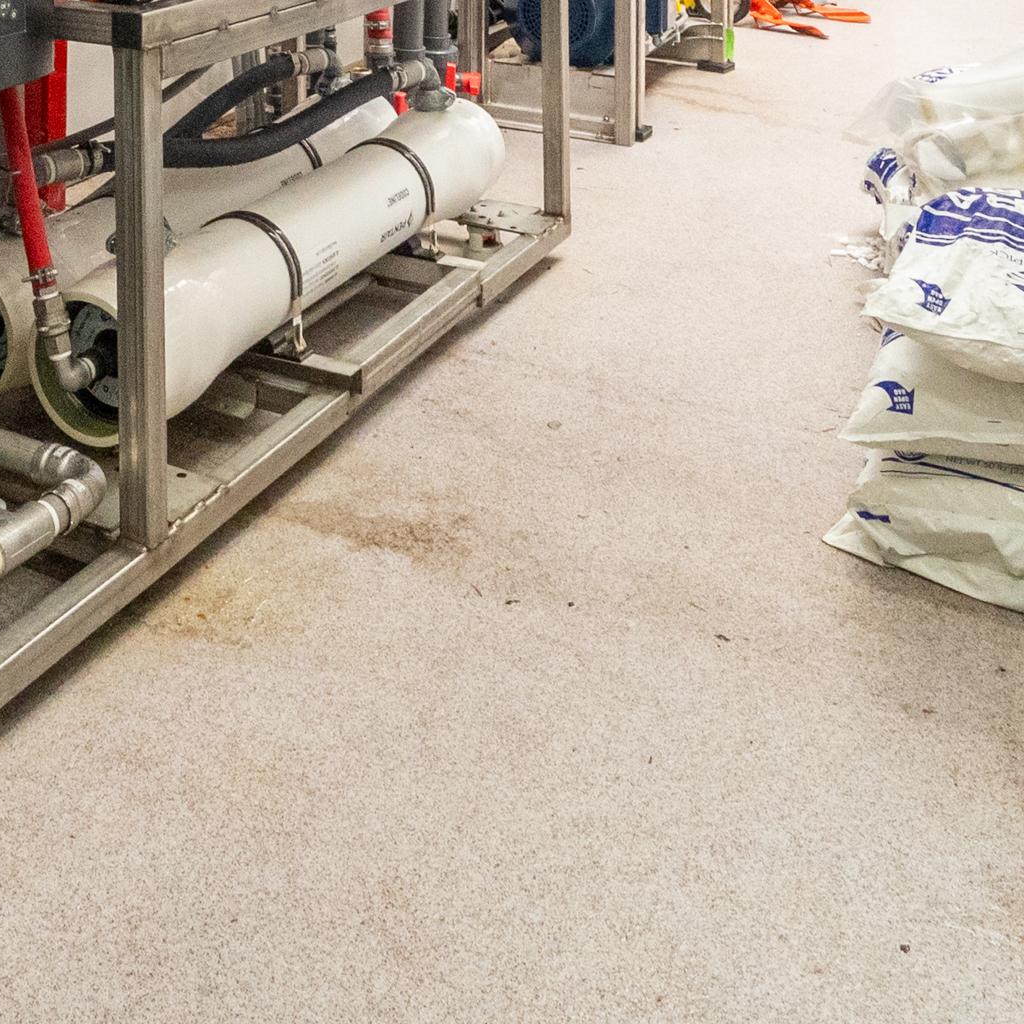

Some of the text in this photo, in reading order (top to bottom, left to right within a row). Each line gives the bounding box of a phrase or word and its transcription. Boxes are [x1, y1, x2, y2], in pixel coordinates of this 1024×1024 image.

[380, 219, 407, 243] PENTAIR
[927, 295, 944, 306] OPEN
[926, 303, 942, 313] EASY
